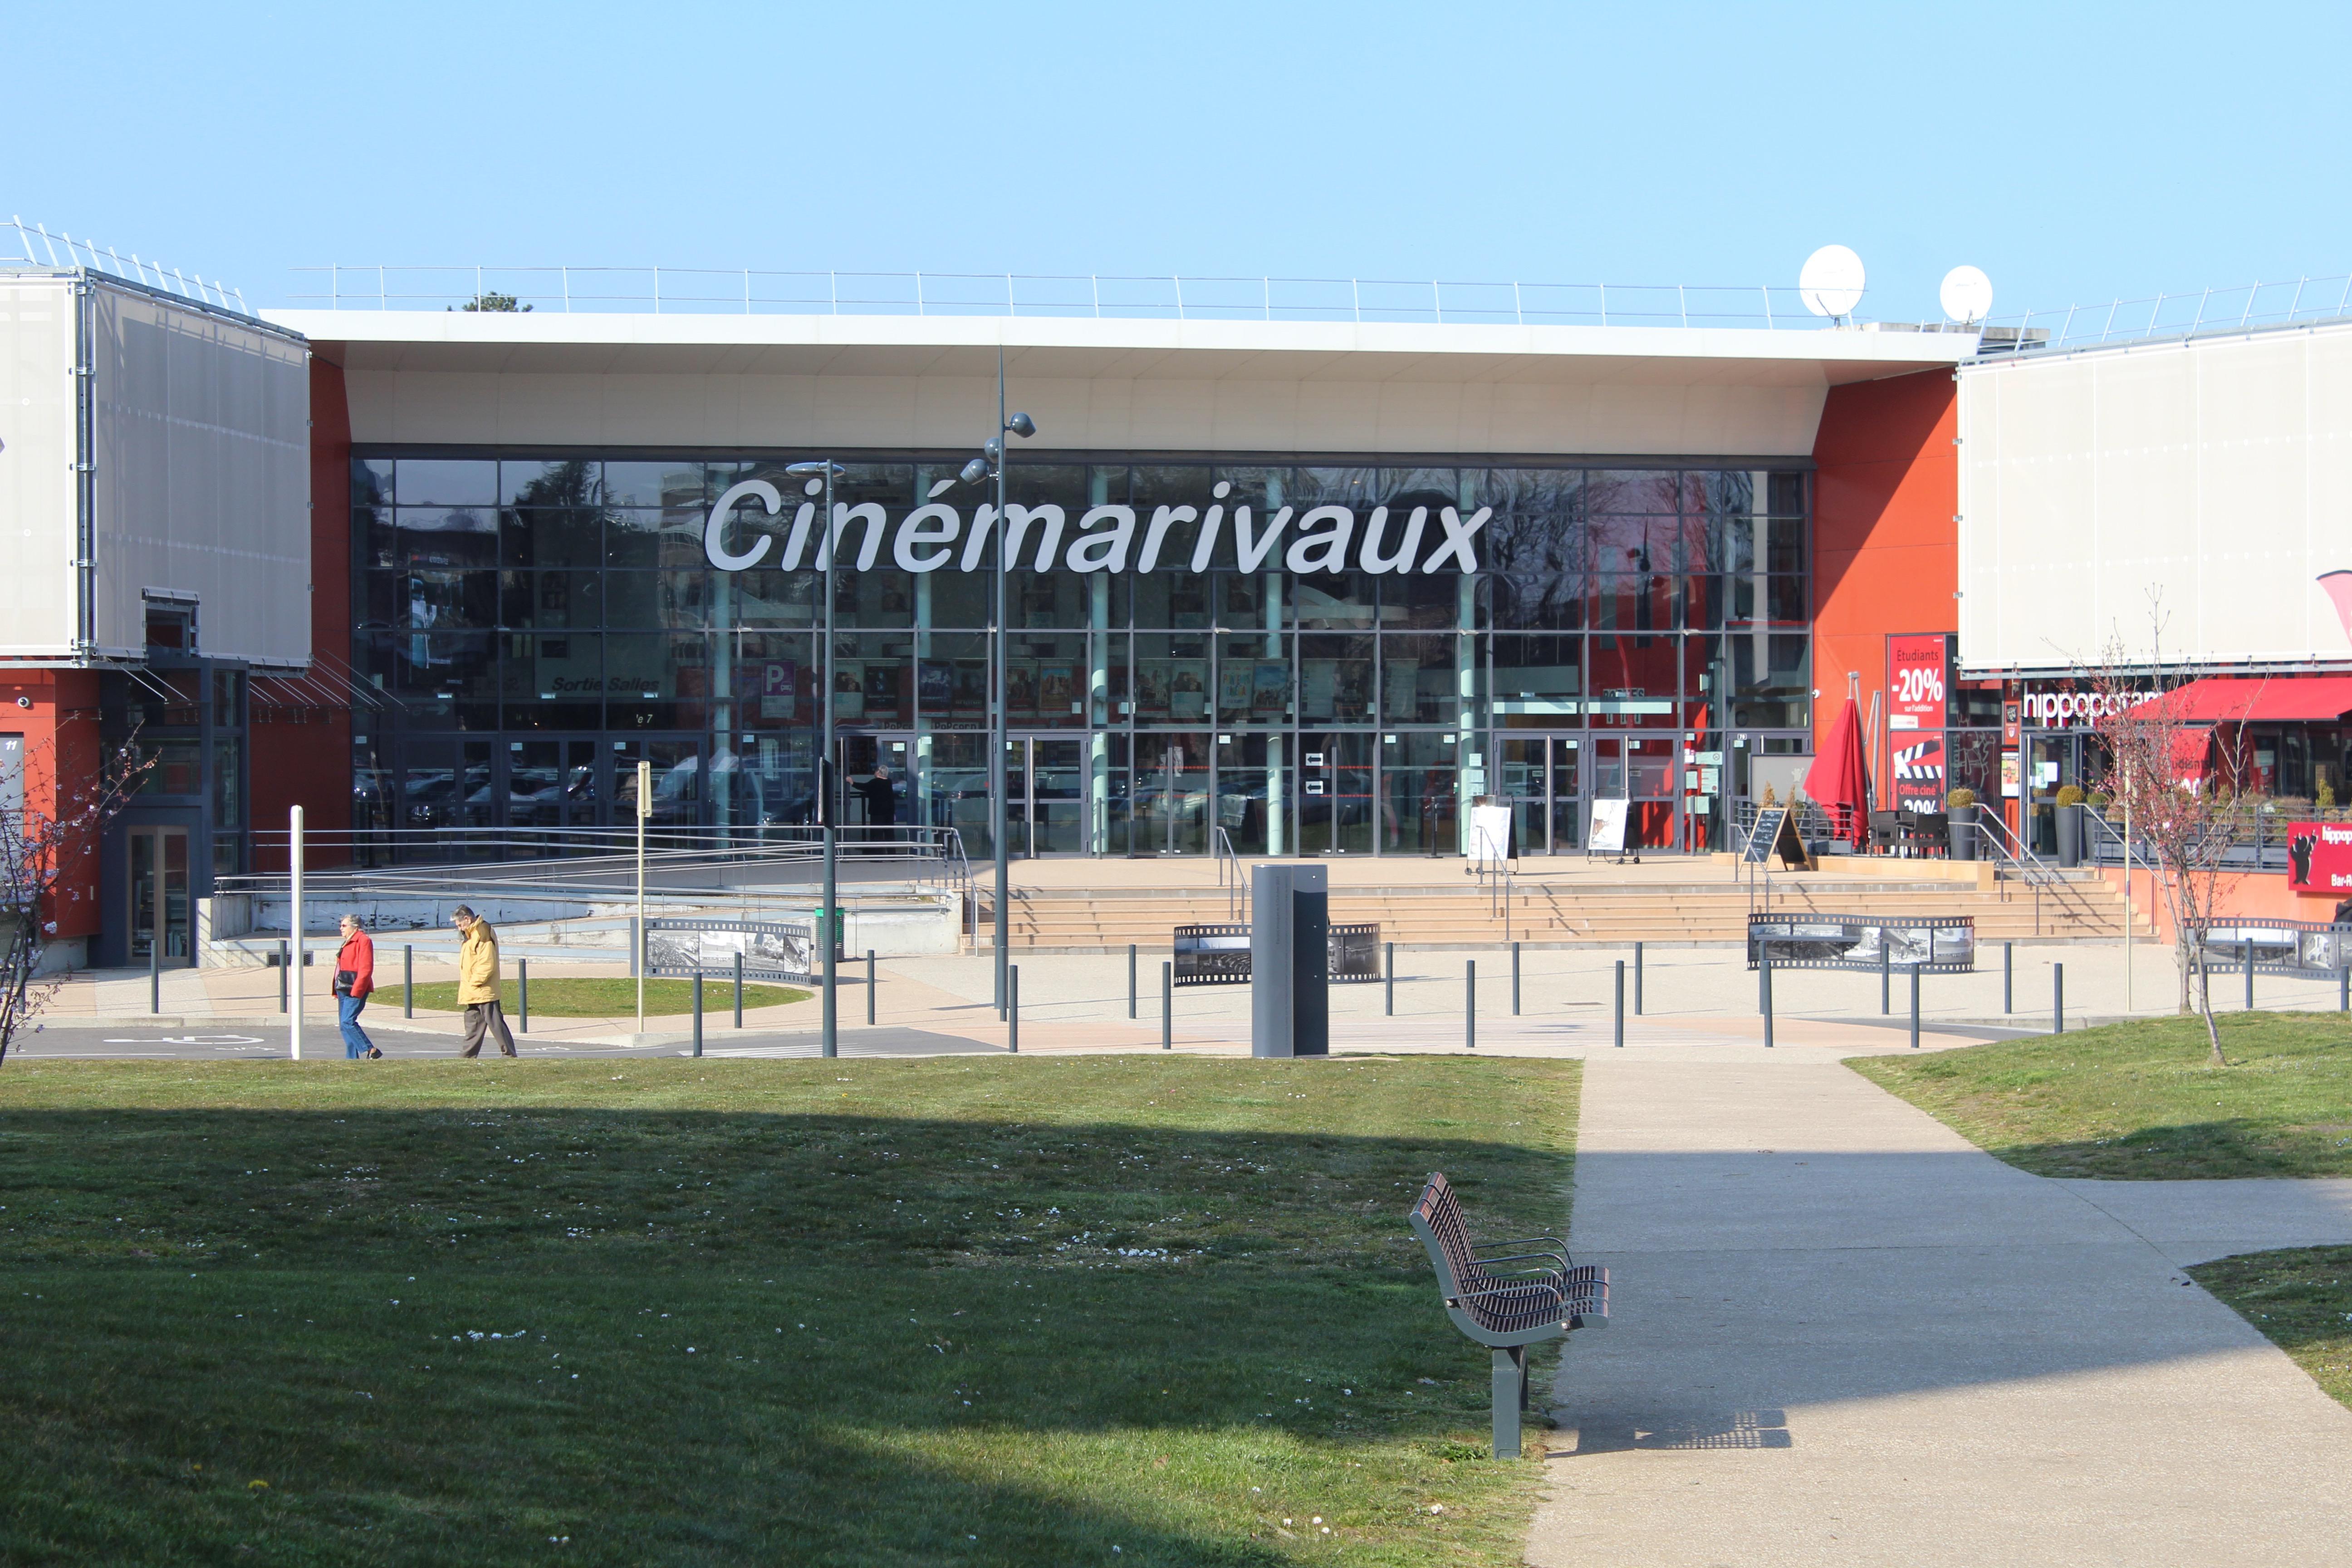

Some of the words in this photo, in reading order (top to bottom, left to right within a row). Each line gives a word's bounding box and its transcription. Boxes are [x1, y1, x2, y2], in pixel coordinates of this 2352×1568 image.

[705, 478, 1493, 575] Cinémarivaux
[552, 676, 603, 691] Sortie
[608, 676, 660, 691] Salles
[766, 665, 784, 692] P
[1891, 668, 1943, 702] -20%
[5, 740, 17, 751] 11
[1899, 784, 1920, 796] Offre
